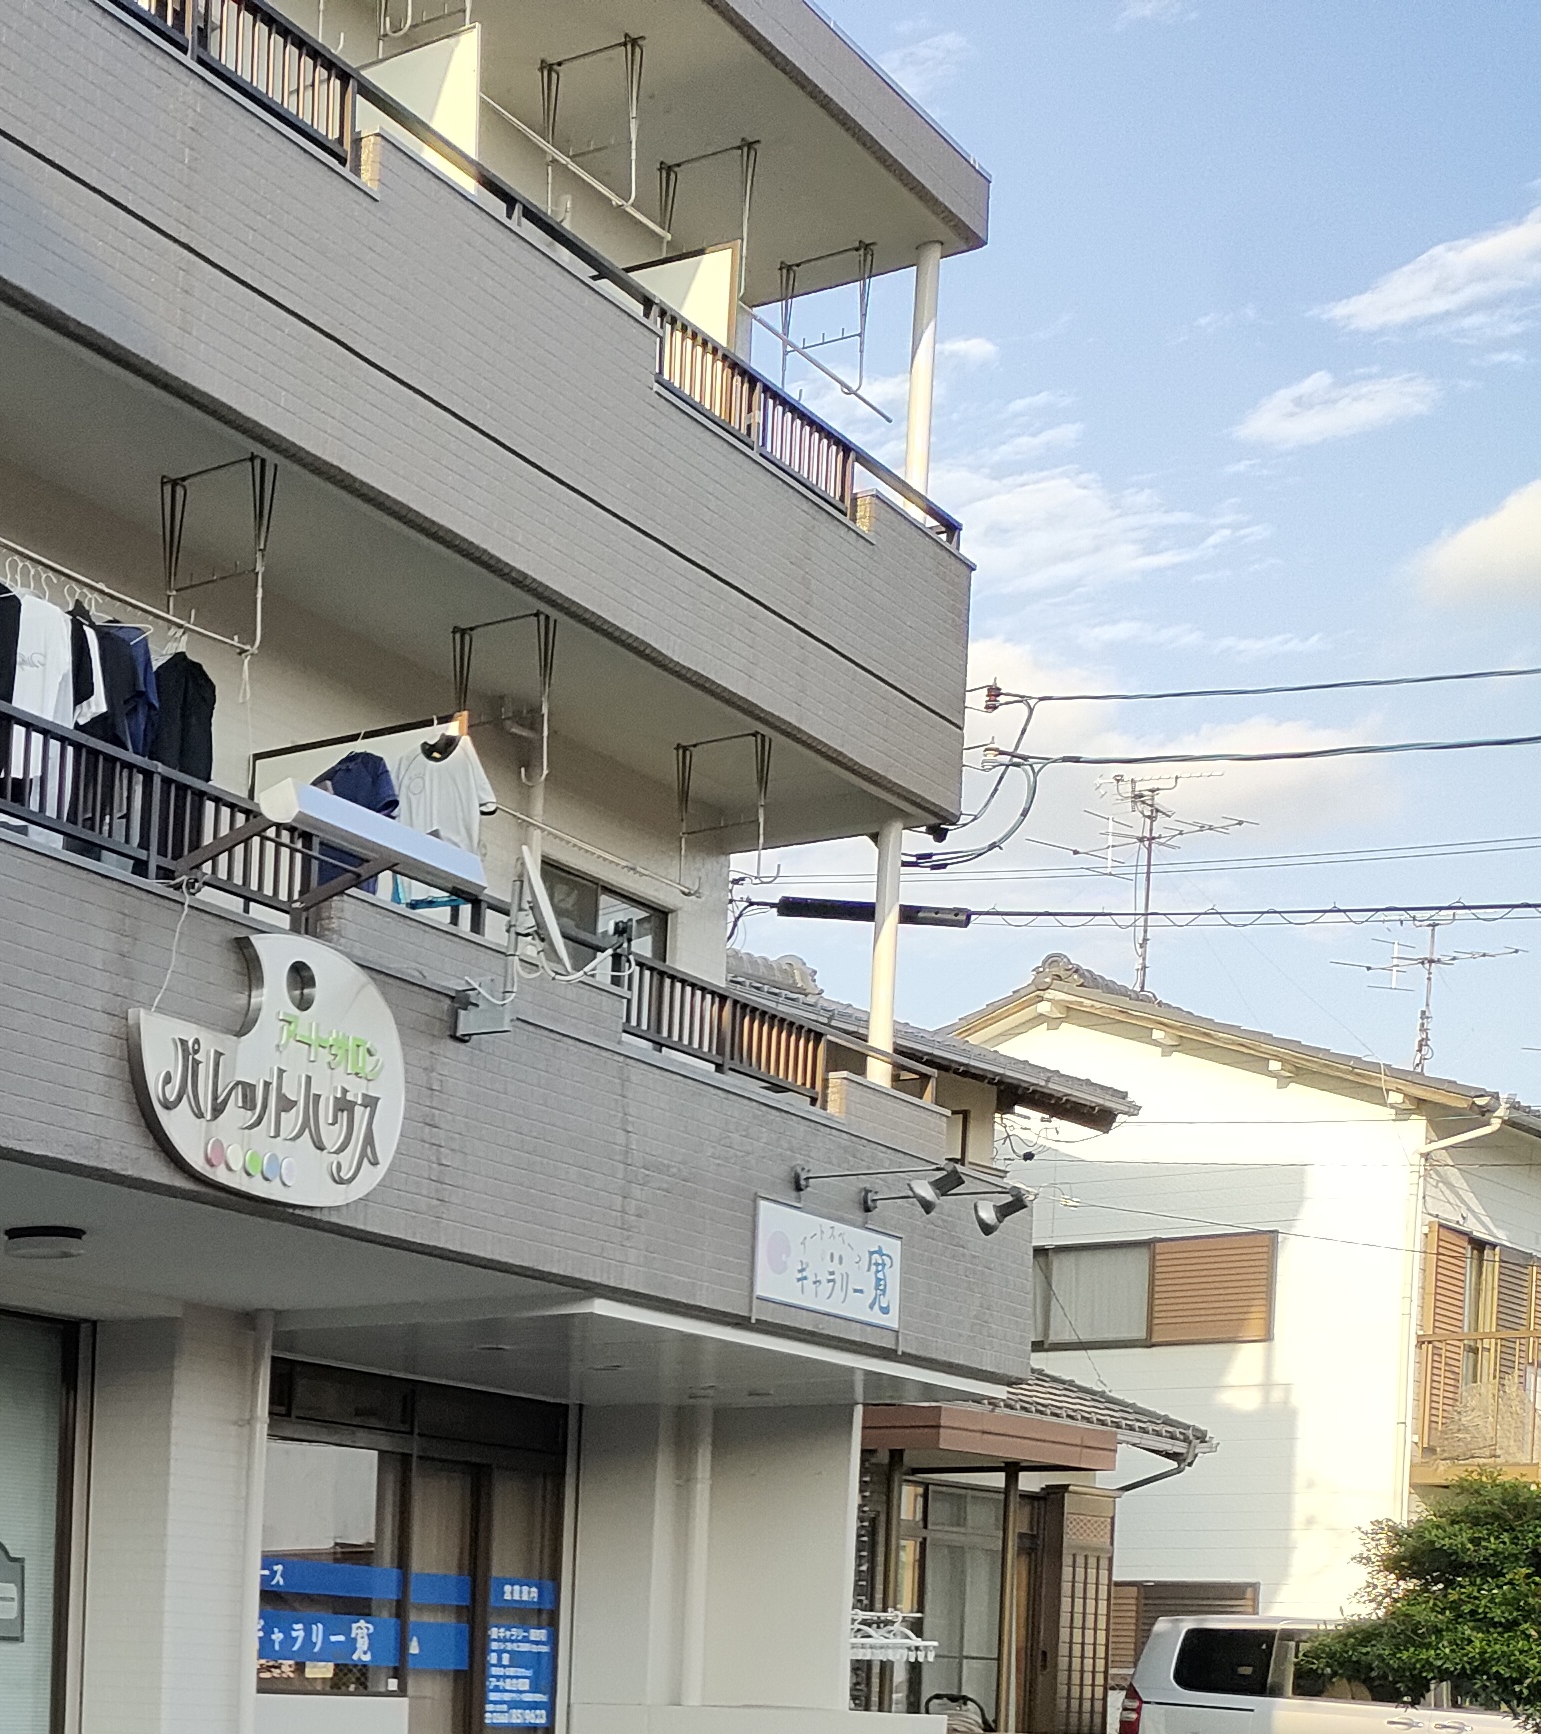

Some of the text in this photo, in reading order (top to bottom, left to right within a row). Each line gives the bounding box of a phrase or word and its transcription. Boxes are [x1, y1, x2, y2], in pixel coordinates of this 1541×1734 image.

[276, 1011, 384, 1080] アートサロン
[158, 1037, 382, 1184] パレットハウス
